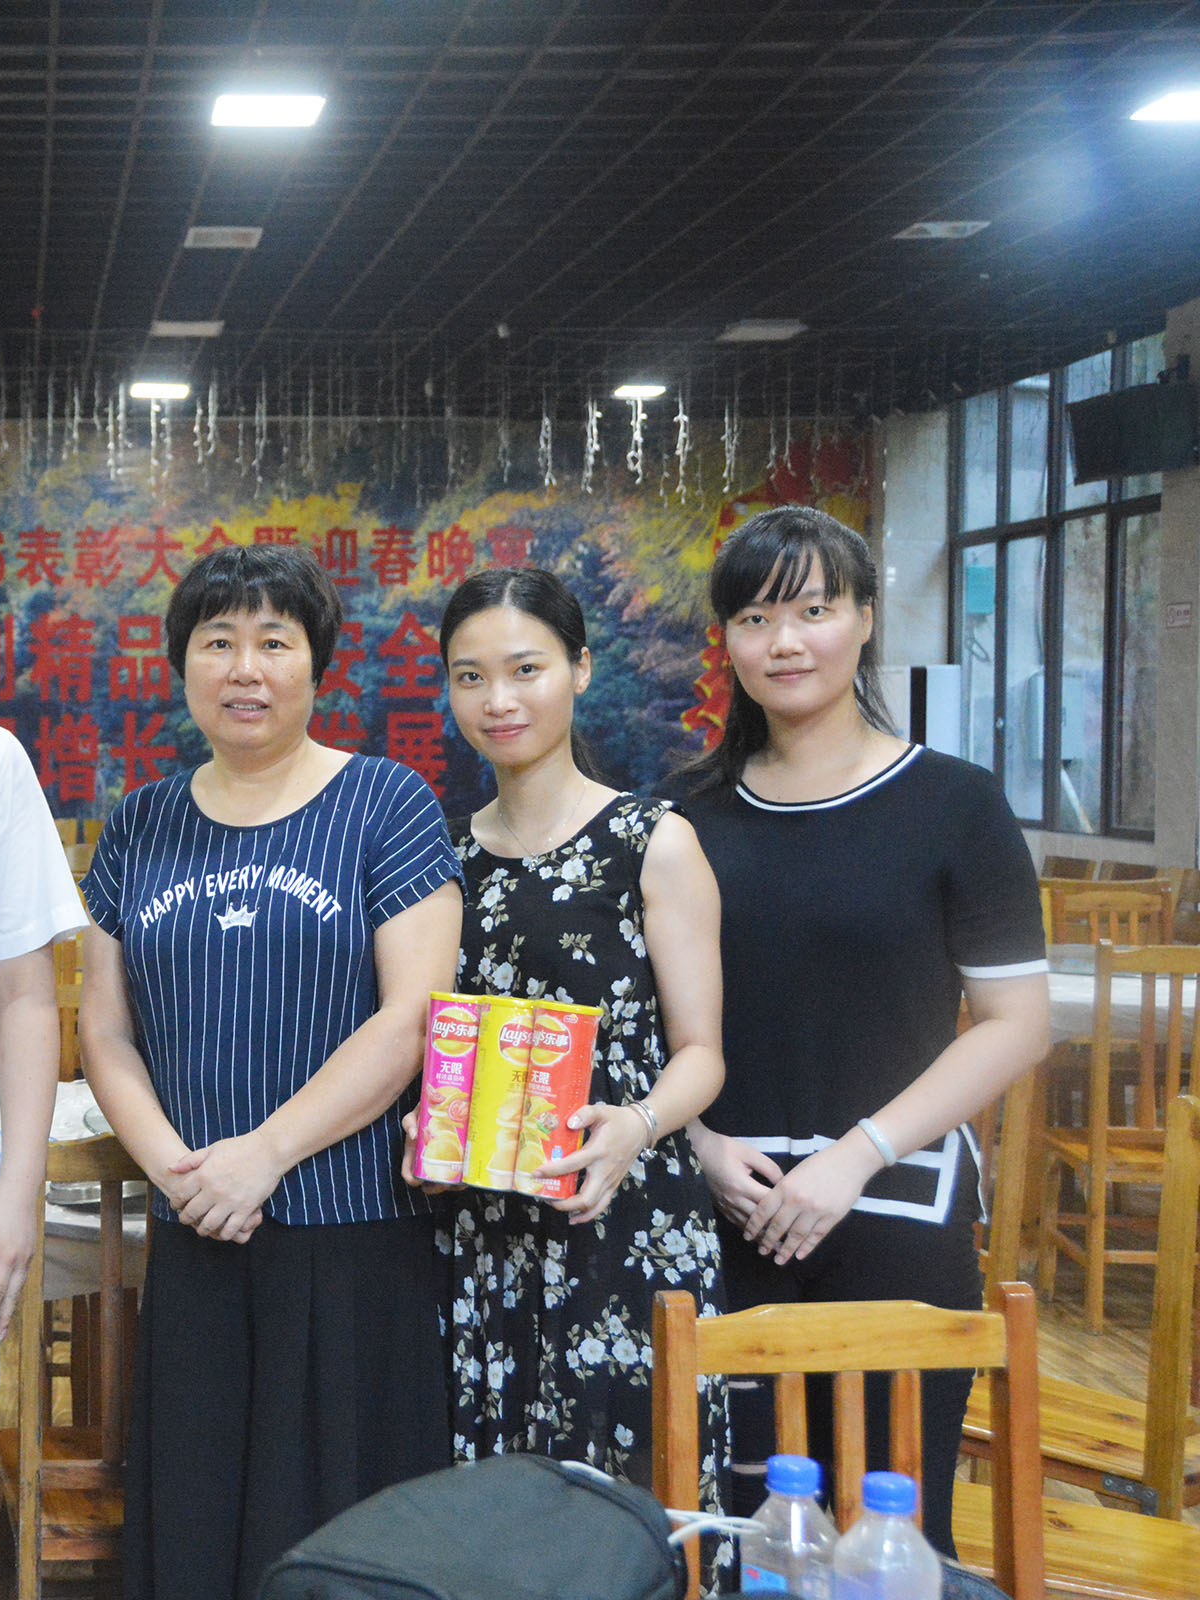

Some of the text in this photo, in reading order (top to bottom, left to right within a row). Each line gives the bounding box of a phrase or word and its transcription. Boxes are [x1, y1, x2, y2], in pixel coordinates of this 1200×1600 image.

[139, 864, 343, 929] HAPPY EVERY MOMENT
[440, 1060, 463, 1075] 无限
